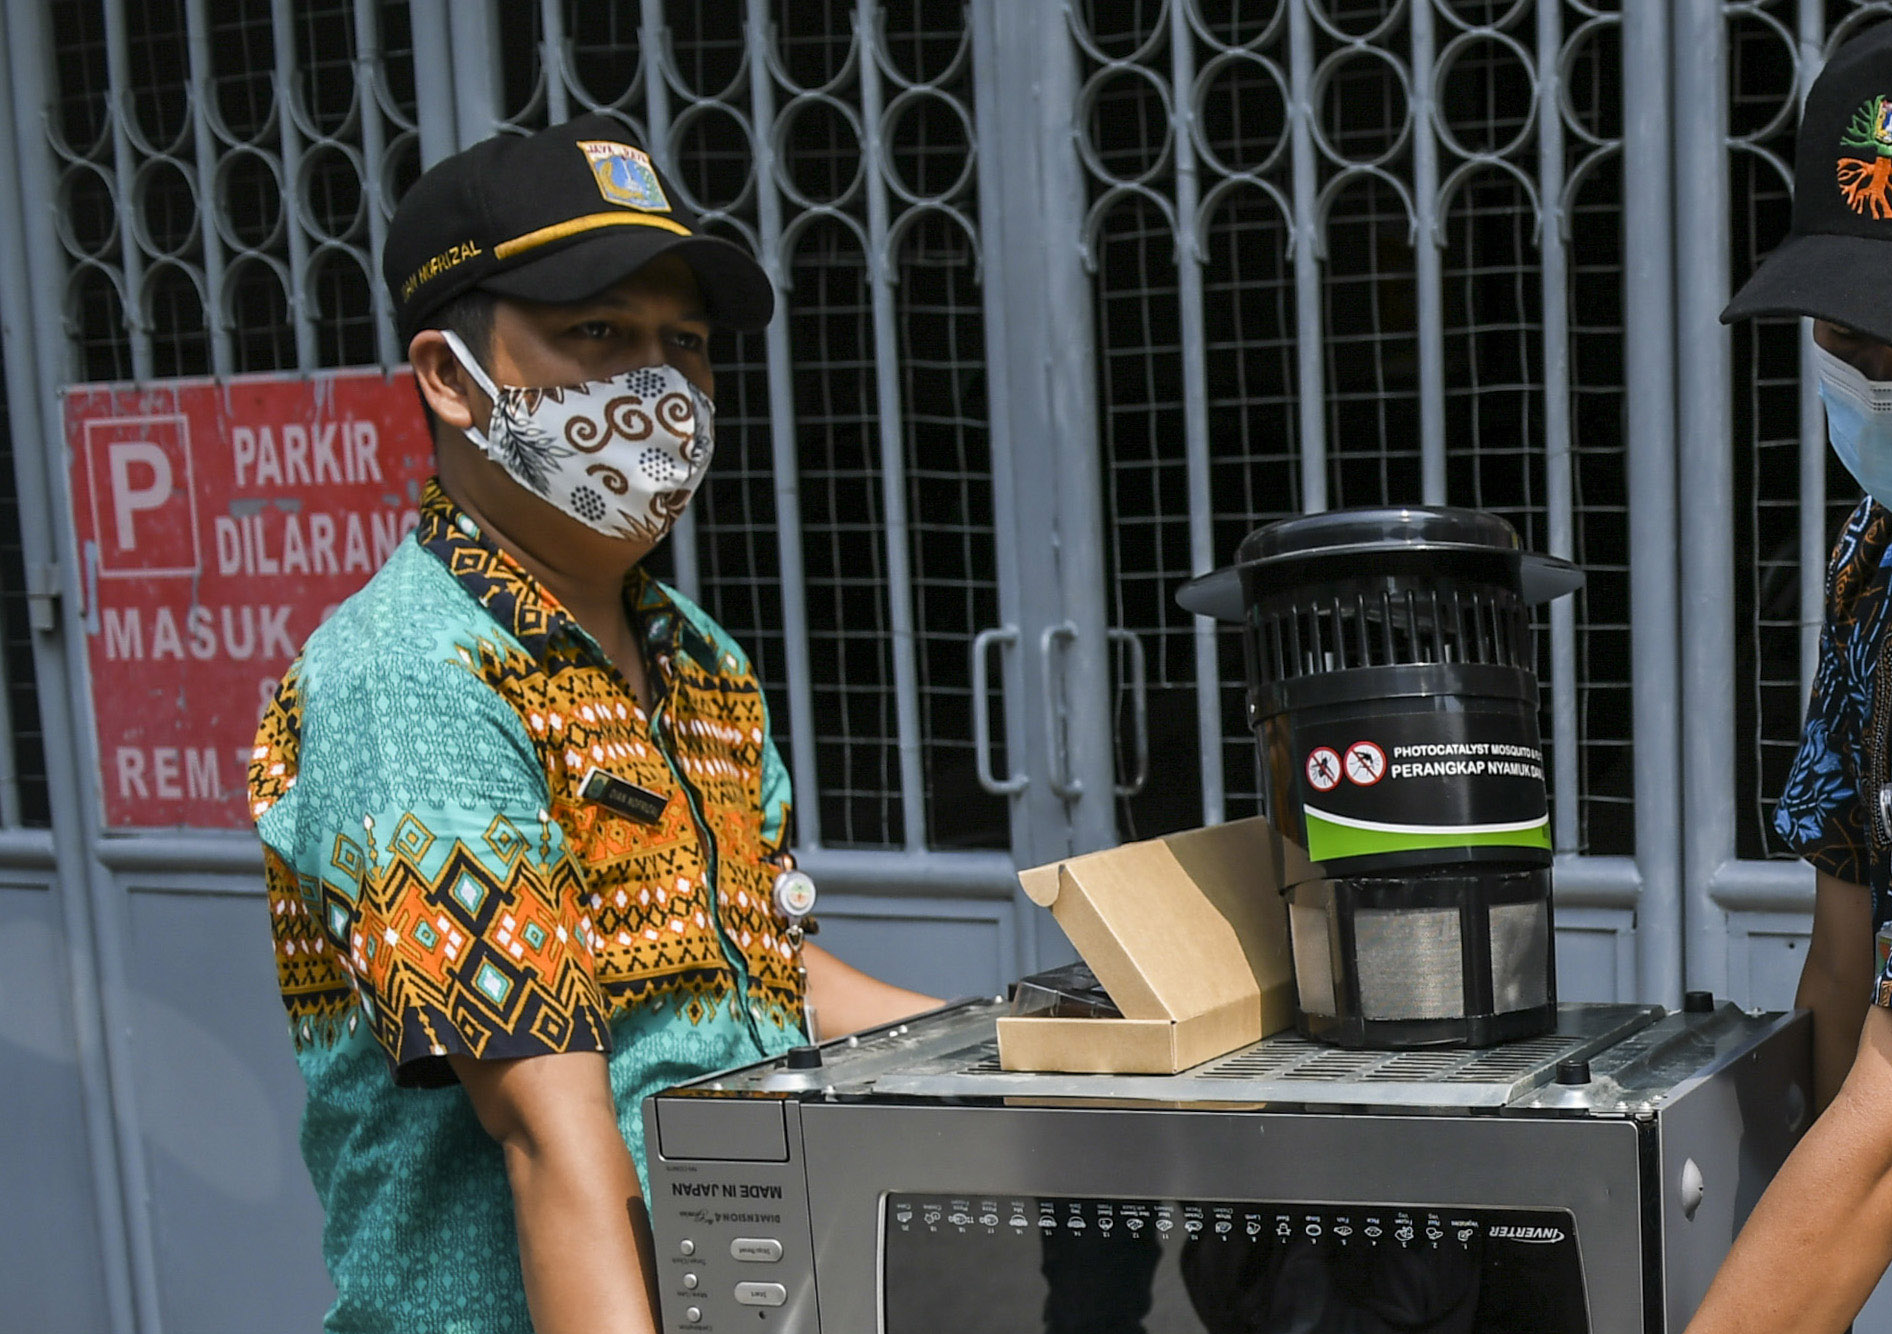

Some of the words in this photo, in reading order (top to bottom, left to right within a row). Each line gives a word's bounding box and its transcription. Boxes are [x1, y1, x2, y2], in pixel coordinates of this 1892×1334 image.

[232, 420, 383, 487] PARKIR
[109, 442, 173, 551] P
[104, 605, 297, 661] MASUK
[1393, 743, 1490, 758] PHOTOCATALYST
[1490, 744, 1531, 758] MOSQUITO
[116, 746, 221, 799] REM
[1391, 760, 1486, 779] PERANGKAP
[1487, 761, 1531, 777] NYAMUK
[672, 1183, 719, 1197] JAPAN
[722, 1184, 737, 1198] IN
[740, 1184, 783, 1199] MADE
[1489, 1226, 1562, 1241] INVERTER
